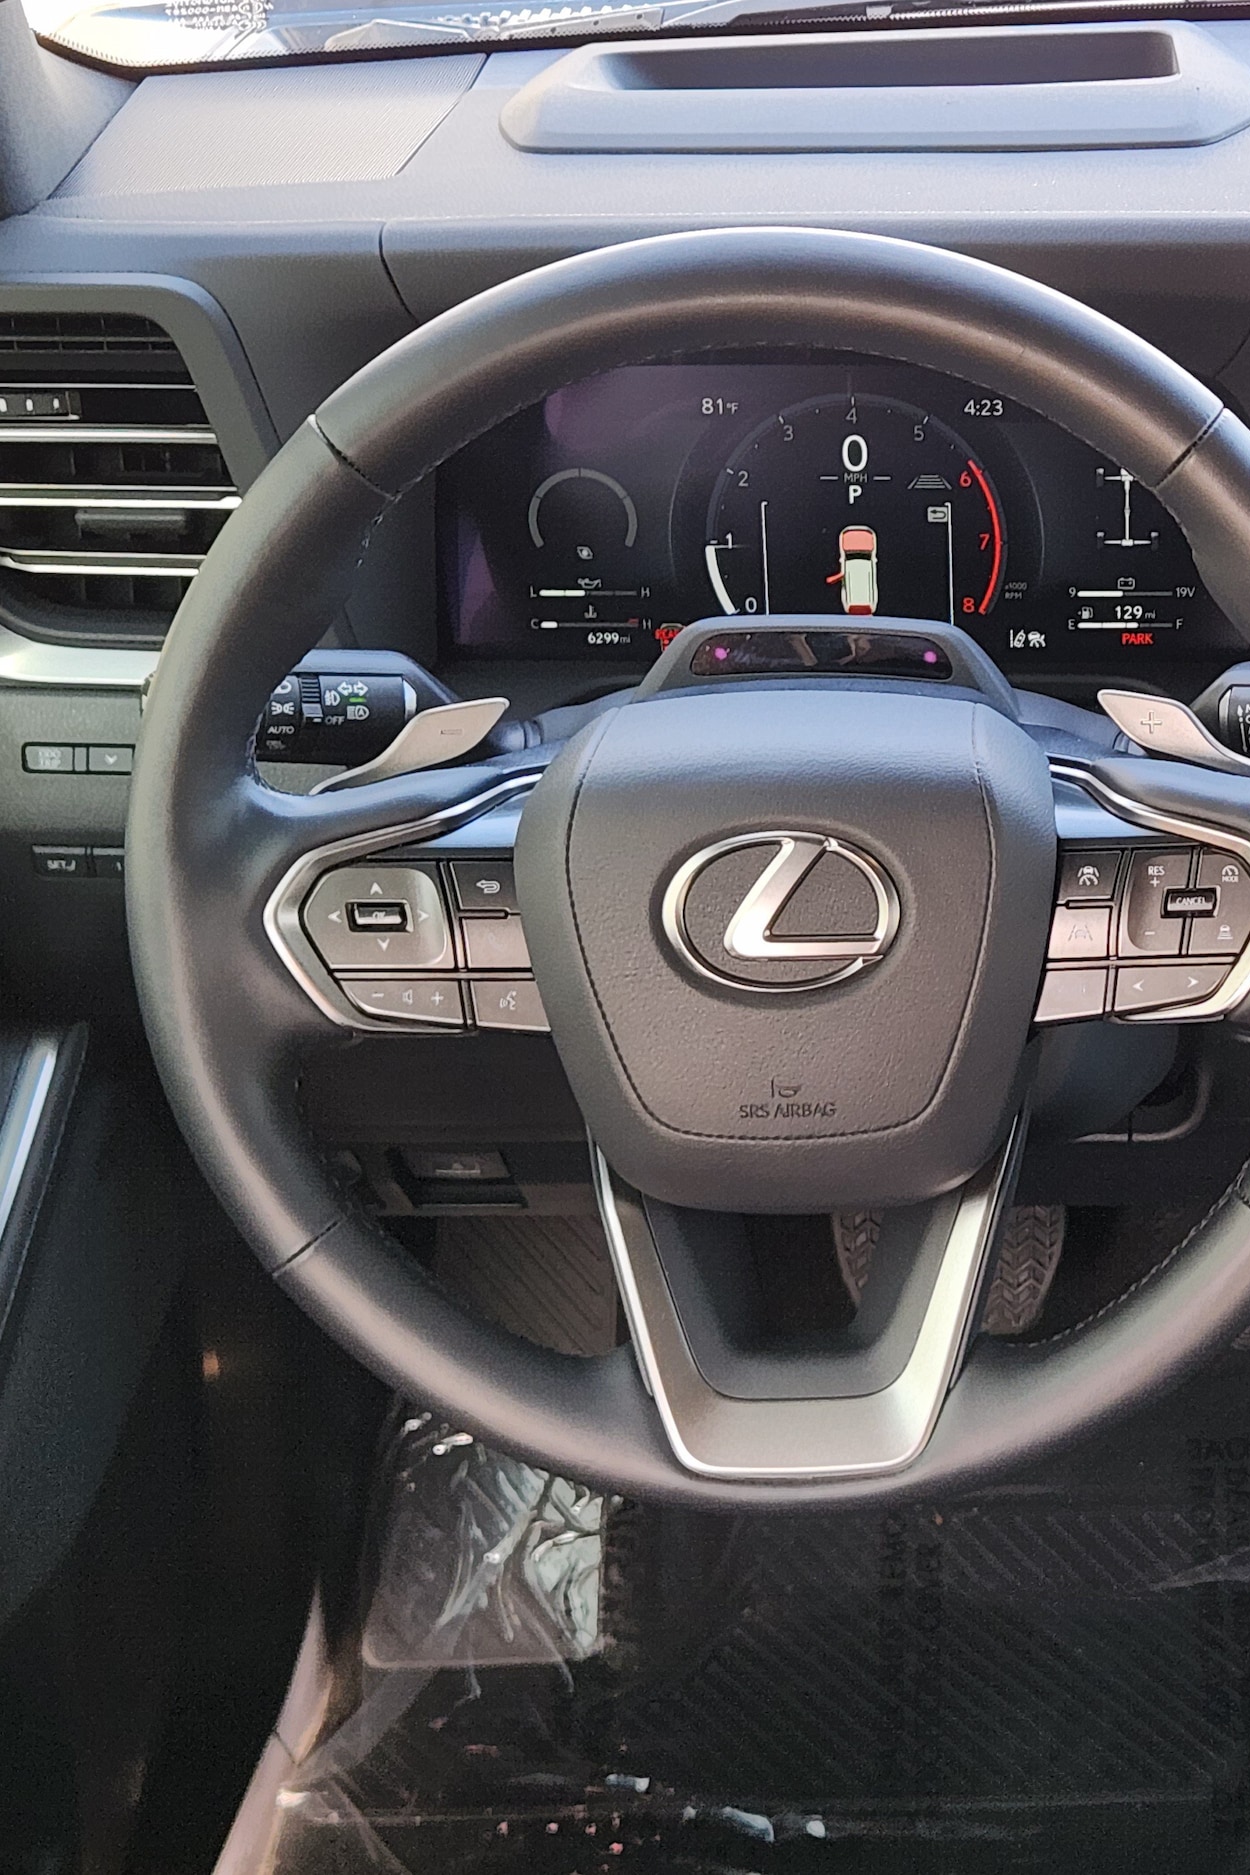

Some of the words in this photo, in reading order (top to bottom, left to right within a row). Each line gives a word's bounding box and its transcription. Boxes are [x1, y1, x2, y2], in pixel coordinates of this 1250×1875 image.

[964, 399, 1003, 416] 4:23
[846, 408, 857, 423] 4
[783, 426, 794, 442] 3
[914, 425, 924, 441] 5
[841, 434, 869, 473] 0
[738, 471, 749, 487] 2
[844, 473, 867, 483] MPH
[959, 472, 972, 487] 6
[849, 485, 862, 504] P
[725, 533, 733, 548] 1
[979, 534, 989, 549] 7
[530, 586, 537, 597] L
[641, 587, 650, 597] H
[1068, 587, 1076, 598] 9
[1175, 587, 1195, 598] 19V
[745, 597, 758, 612] 0
[962, 598, 975, 612] 8
[1115, 605, 1143, 619] 129
[1145, 609, 1156, 618] mi
[531, 619, 539, 629] C
[1068, 619, 1075, 630] E
[1176, 618, 1183, 629] F
[1121, 633, 1153, 645] PARK
[325, 715, 345, 725] OFF
[267, 725, 295, 735] AUTO
[1148, 866, 1165, 876] RES
[1176, 896, 1207, 905] CANCEL
[739, 1103, 770, 1119] SRS
[774, 1102, 838, 1119] AIRBAG
